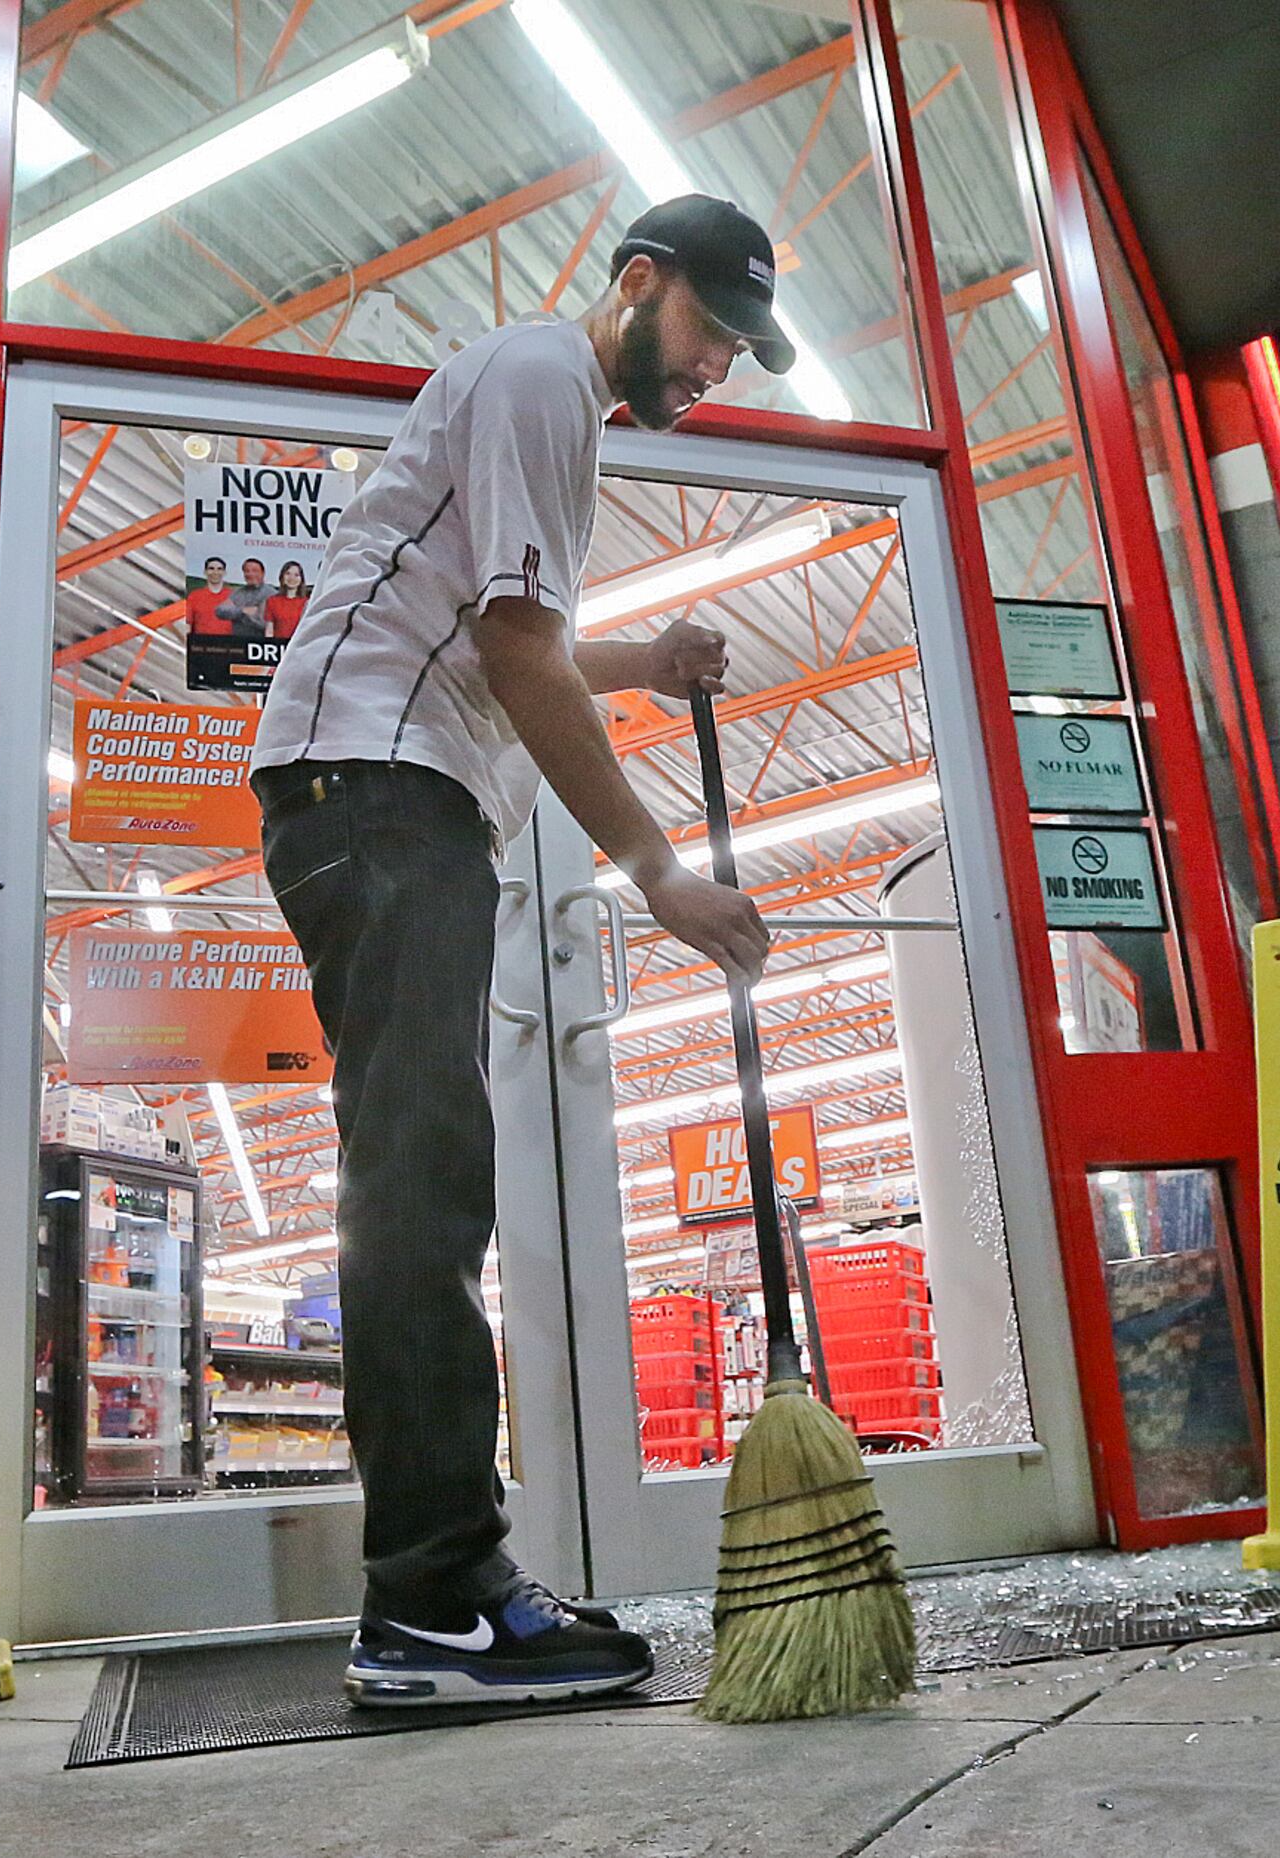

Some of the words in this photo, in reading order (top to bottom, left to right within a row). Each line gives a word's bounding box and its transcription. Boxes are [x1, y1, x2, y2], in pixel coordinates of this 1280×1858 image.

[222, 467, 322, 502] NOW
[244, 539, 285, 549] ESTAMOS
[87, 708, 189, 734] Maintain
[197, 714, 247, 737] Your
[86, 734, 175, 761] Cooling
[85, 760, 245, 788] Performance!
[1038, 760, 1061, 773] NO
[1065, 760, 1123, 775] FUMAR
[128, 817, 198, 833] AutoZone
[1046, 876, 1069, 898] NO
[1072, 876, 1144, 900] SMOKING
[86, 939, 181, 964] Improve
[87, 966, 141, 990] With
[147, 972, 164, 990] a
[169, 966, 226, 990] K&N
[229, 966, 266, 990] Air
[687, 1156, 806, 1209] DEAS
[843, 1200, 880, 1214] SPECIAL
